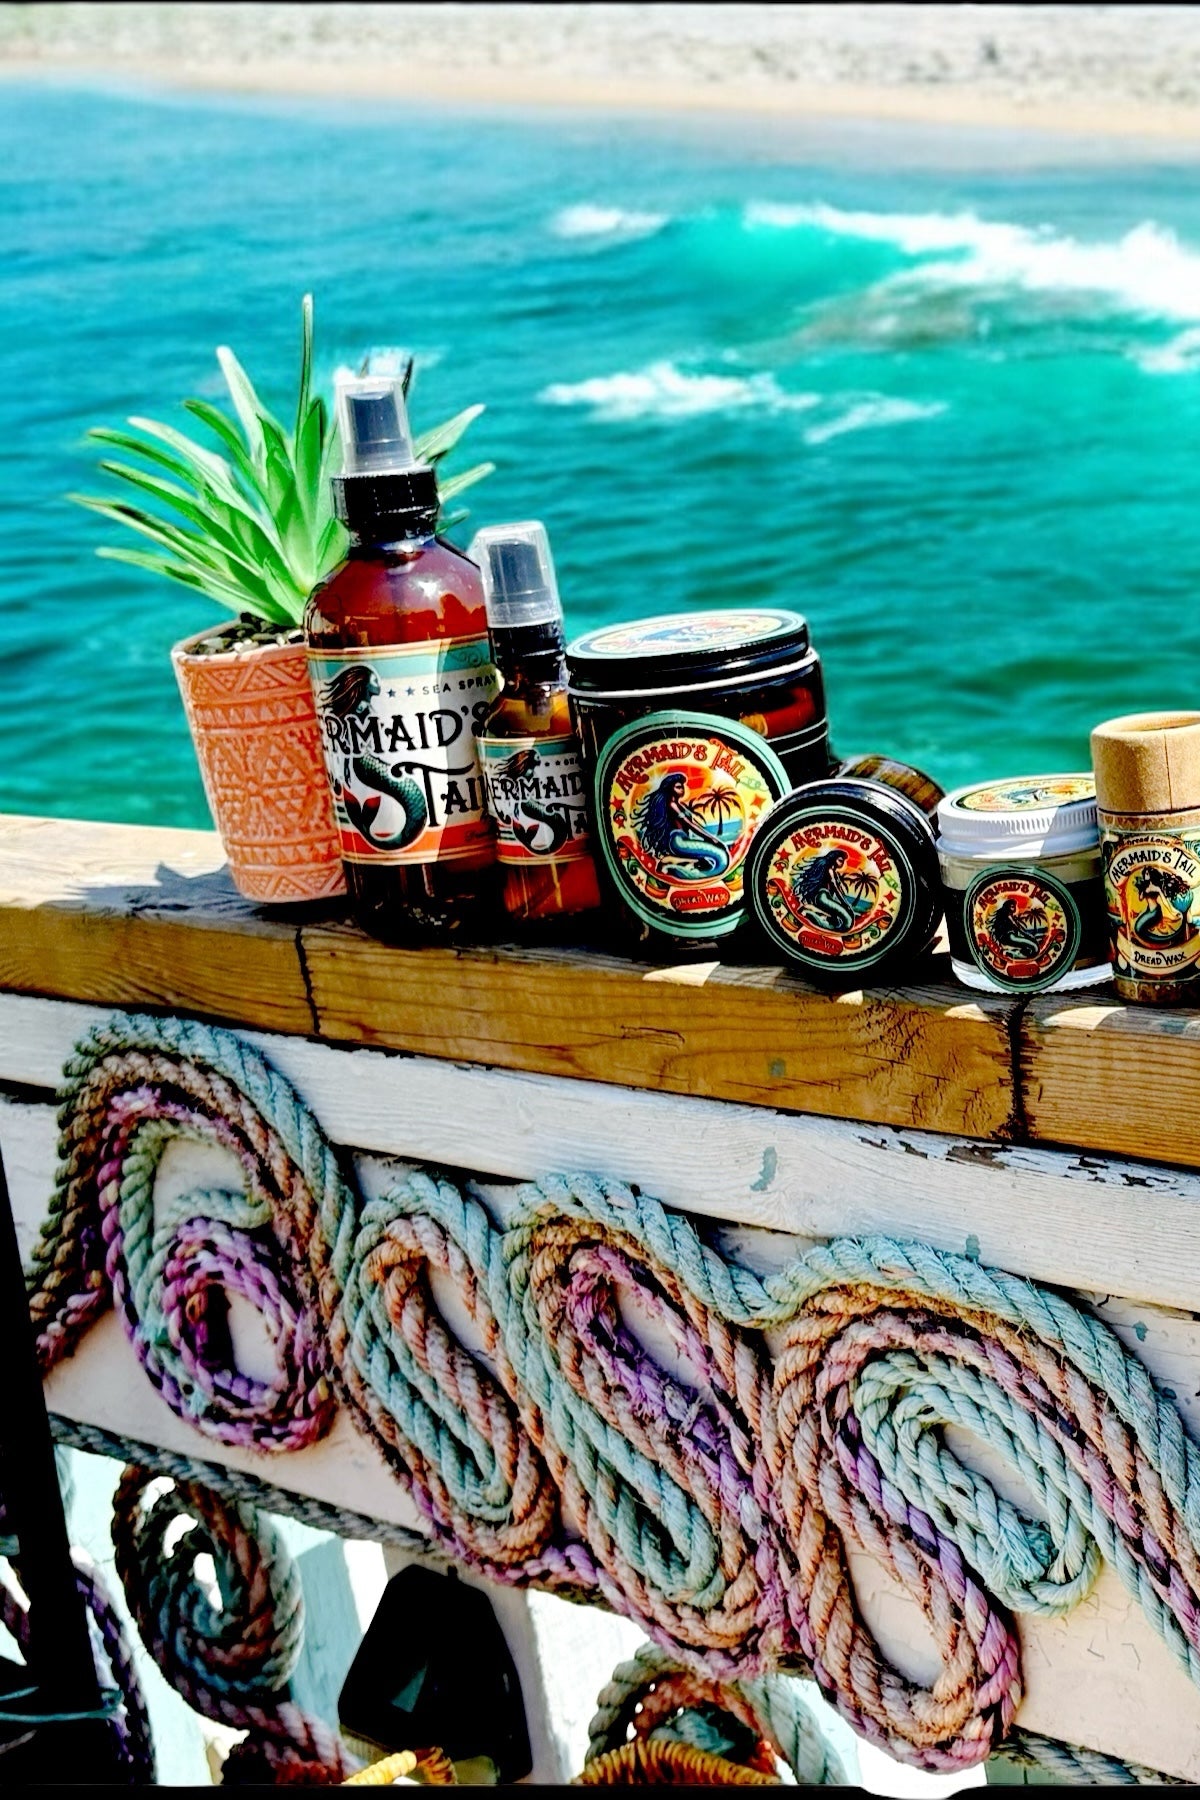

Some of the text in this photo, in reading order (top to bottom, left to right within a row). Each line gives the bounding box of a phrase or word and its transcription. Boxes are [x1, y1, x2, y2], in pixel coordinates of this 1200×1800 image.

[422, 684, 451, 695] SEA
[616, 738, 746, 796] MERMAID'S TAIL
[790, 825, 872, 851] MERMAID'S
[1111, 847, 1197, 883] MERMAID'S TAIL
[1134, 951, 1187, 966] DREAD WAX
